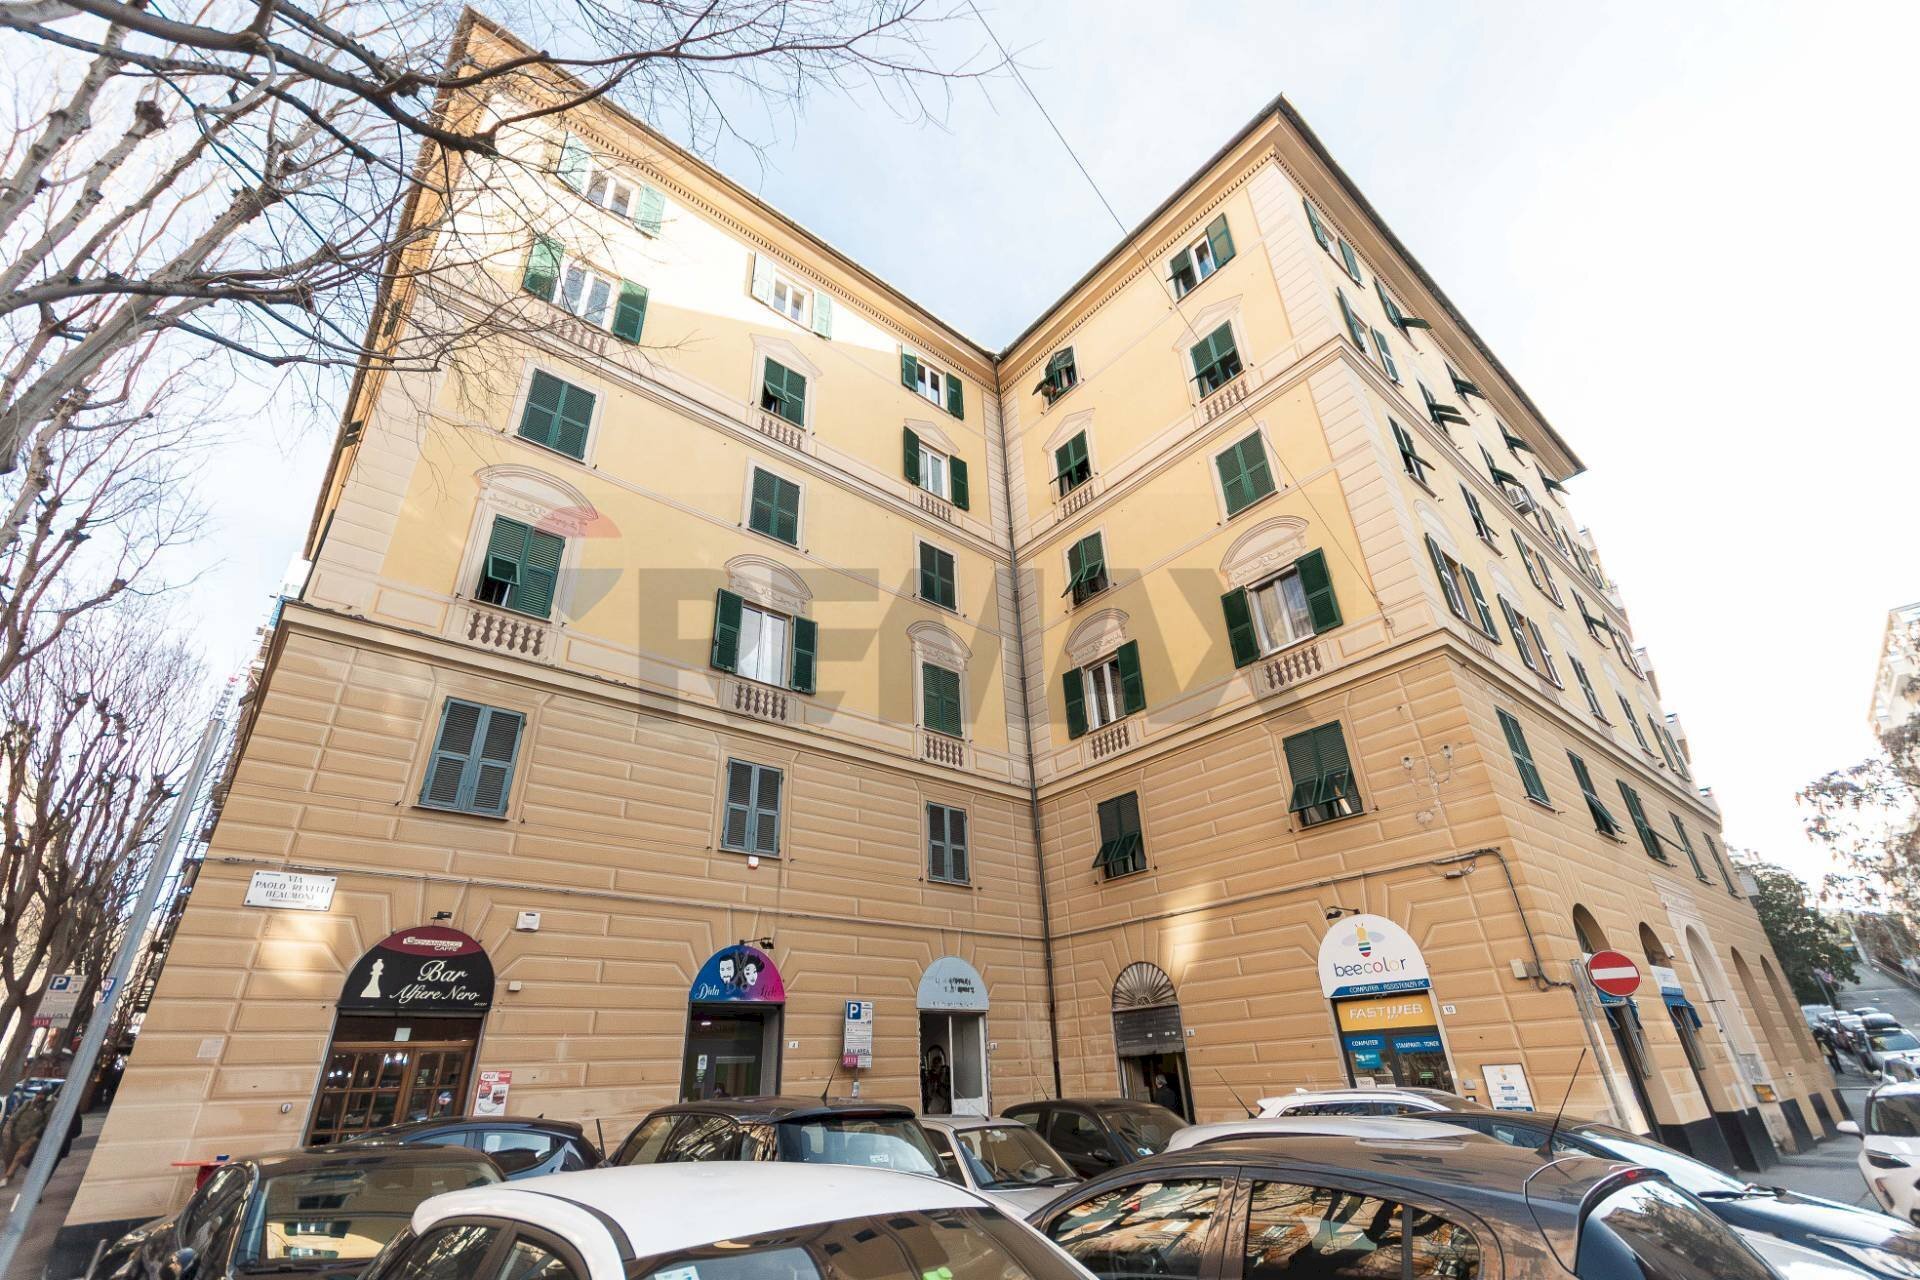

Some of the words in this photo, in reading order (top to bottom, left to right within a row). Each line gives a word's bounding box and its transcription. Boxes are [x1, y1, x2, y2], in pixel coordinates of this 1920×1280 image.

[254, 880, 287, 889] PAOLO
[288, 875, 303, 883] VIA
[417, 959, 468, 983] Bar
[1334, 957, 1406, 977] beecolor
[53, 977, 68, 989] P
[389, 983, 443, 1004] Alfiere
[442, 985, 480, 1001] Nero
[1348, 986, 1380, 994] COMPUTER
[850, 1003, 859, 1018] P
[1349, 1003, 1424, 1020] FASTWEB
[1351, 1039, 1379, 1047] COMPUTER
